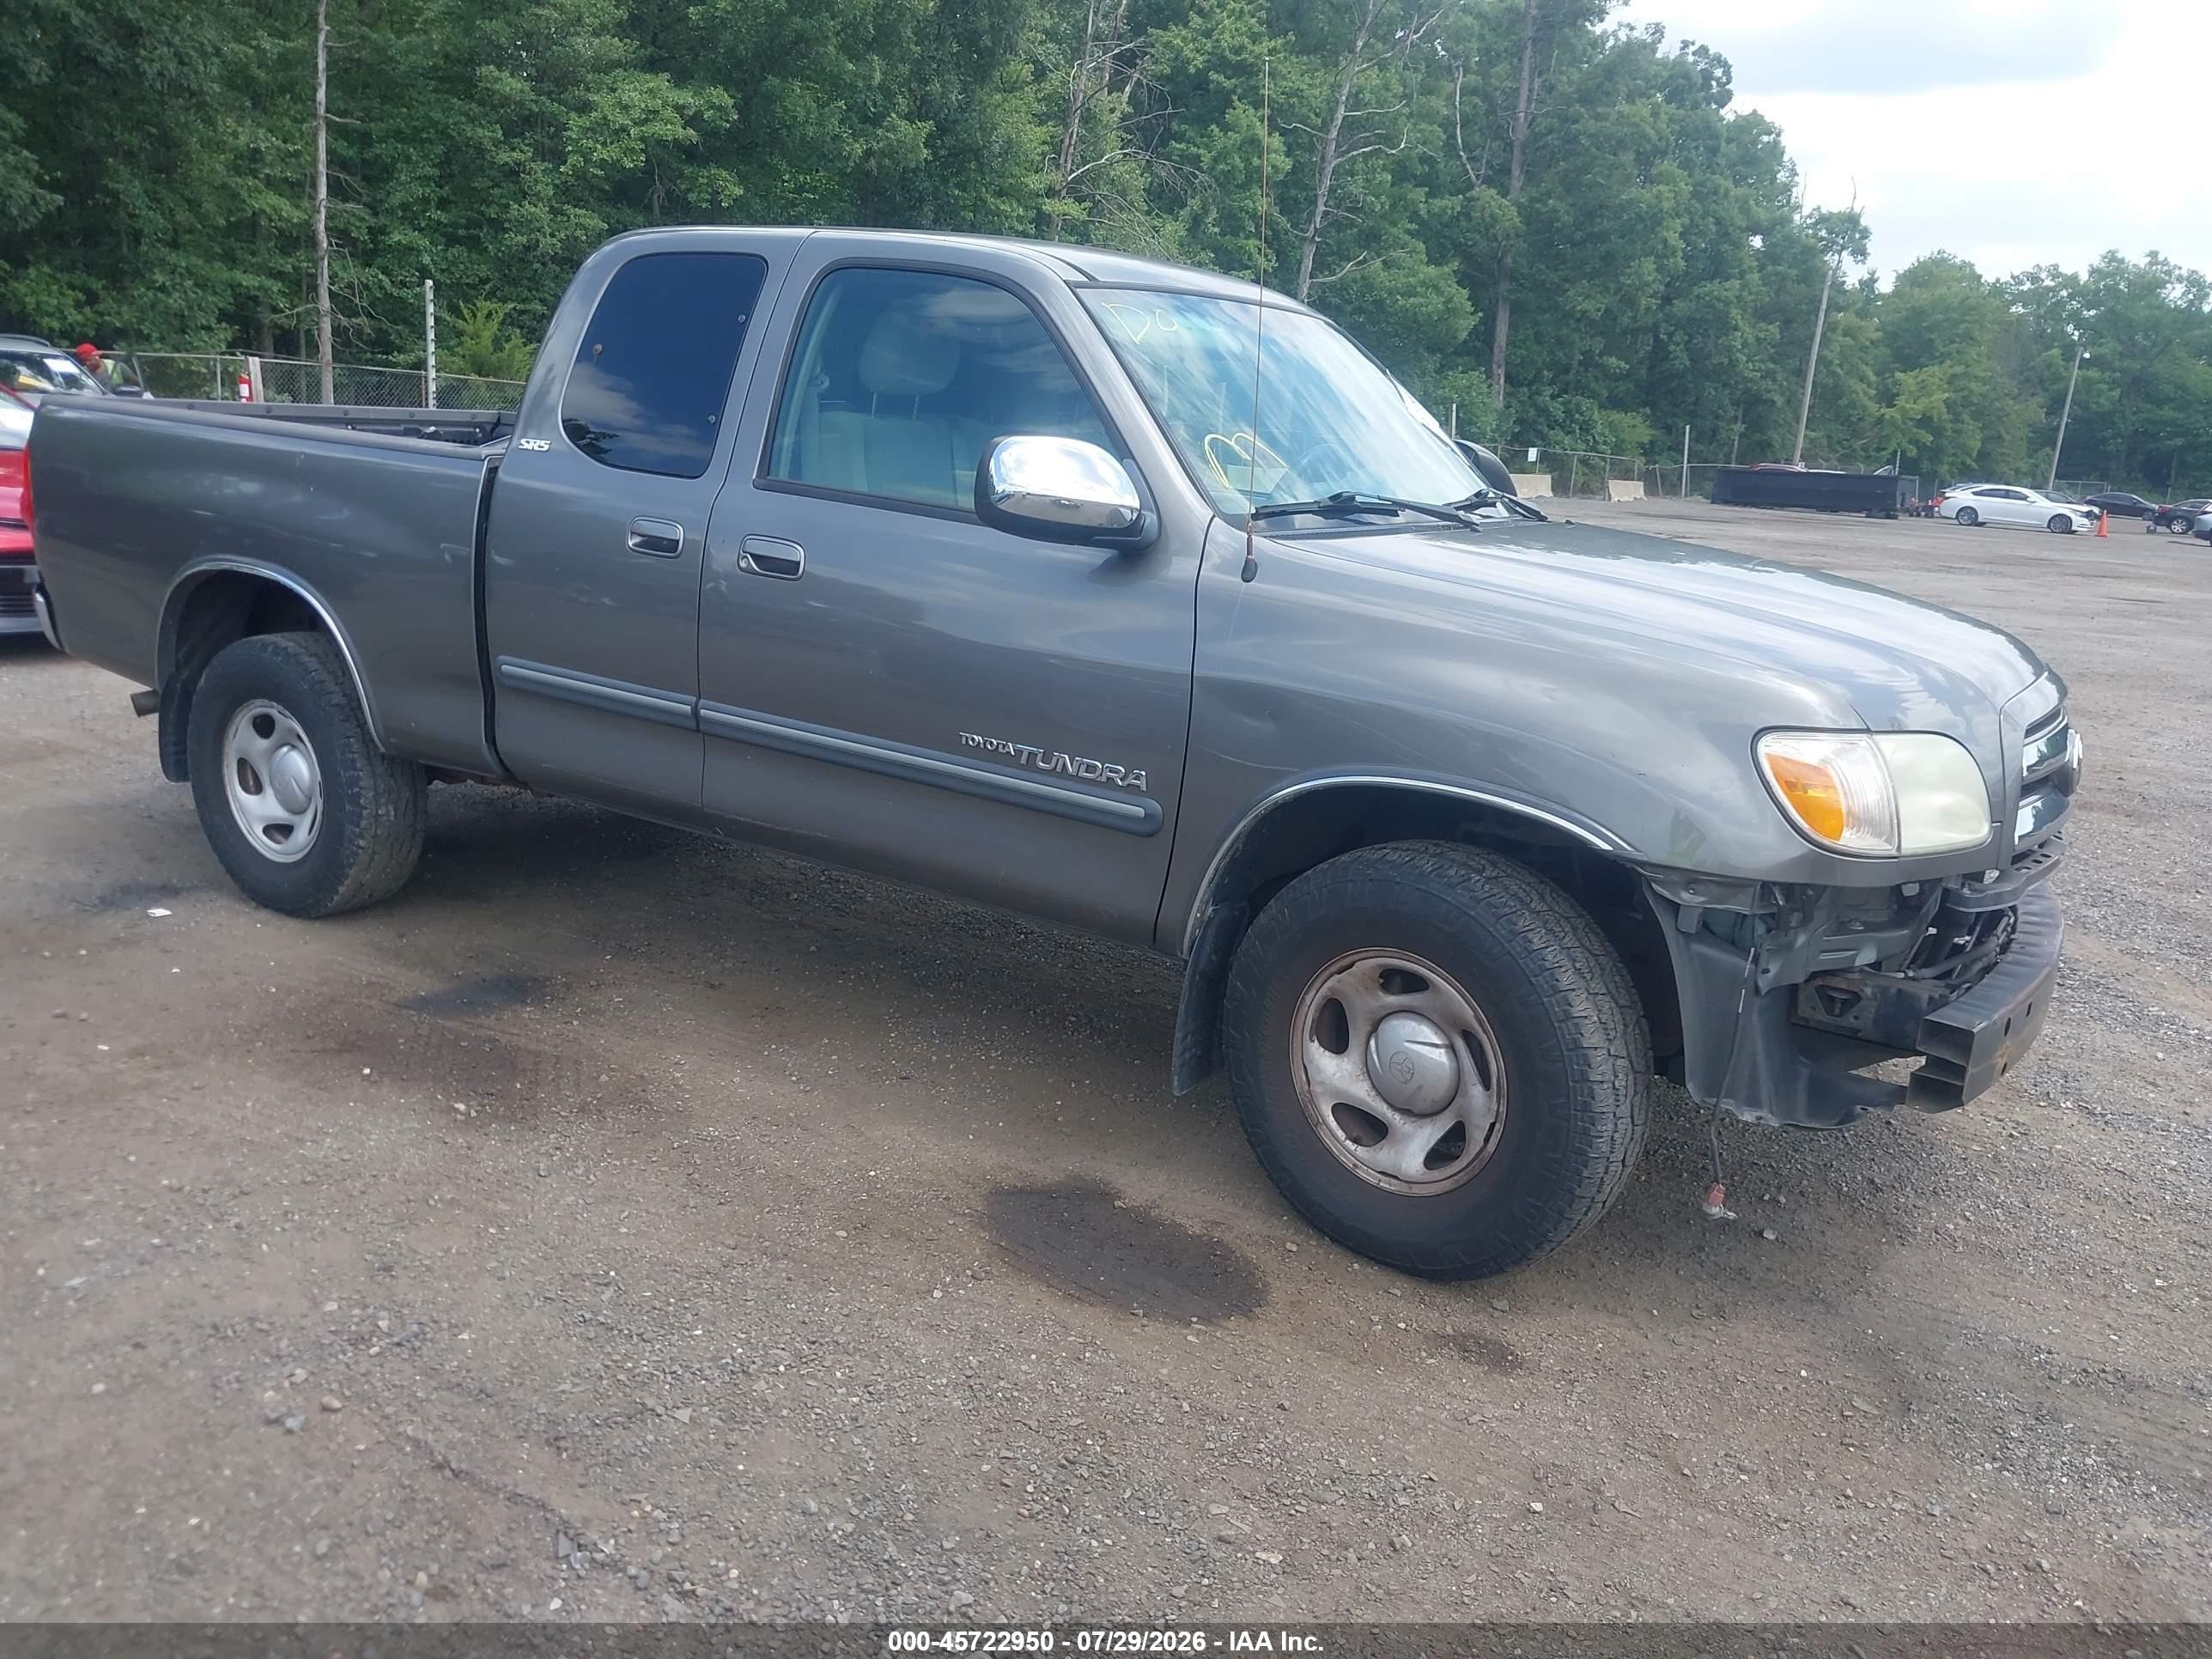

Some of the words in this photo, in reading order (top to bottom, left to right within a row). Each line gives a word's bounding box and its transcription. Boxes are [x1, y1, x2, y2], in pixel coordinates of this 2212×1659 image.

[518, 438, 551, 452] SR5
[958, 732, 1015, 756] TOYOTA
[1013, 744, 1147, 792] TUNDRA
